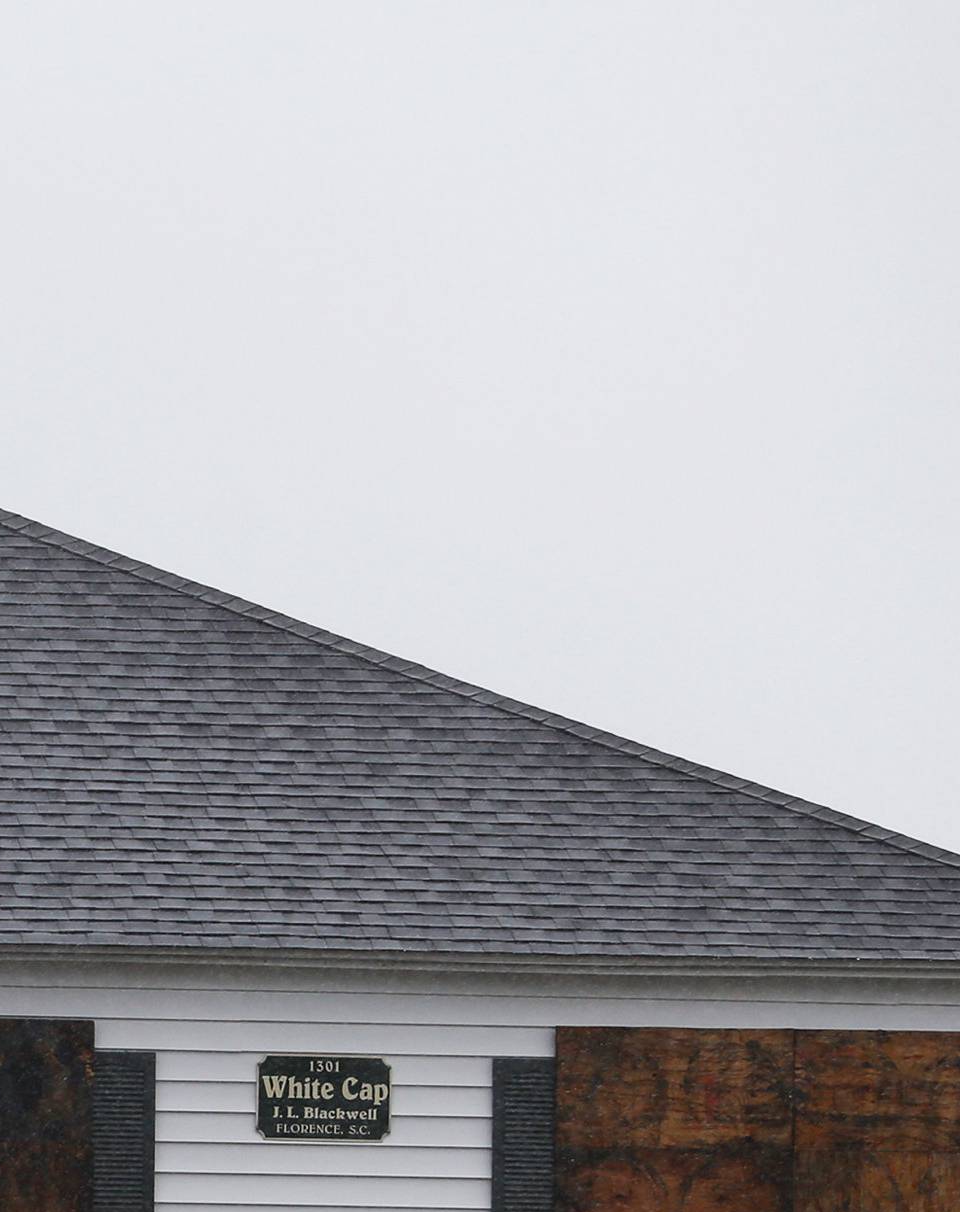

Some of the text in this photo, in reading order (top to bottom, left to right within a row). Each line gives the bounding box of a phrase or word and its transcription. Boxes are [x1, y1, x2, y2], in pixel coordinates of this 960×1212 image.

[310, 1060, 340, 1073] 1301
[262, 1075, 389, 1105] White Cap
[273, 1106, 378, 1121] J. L. Blackwell
[348, 1125, 371, 1135] S.C.
